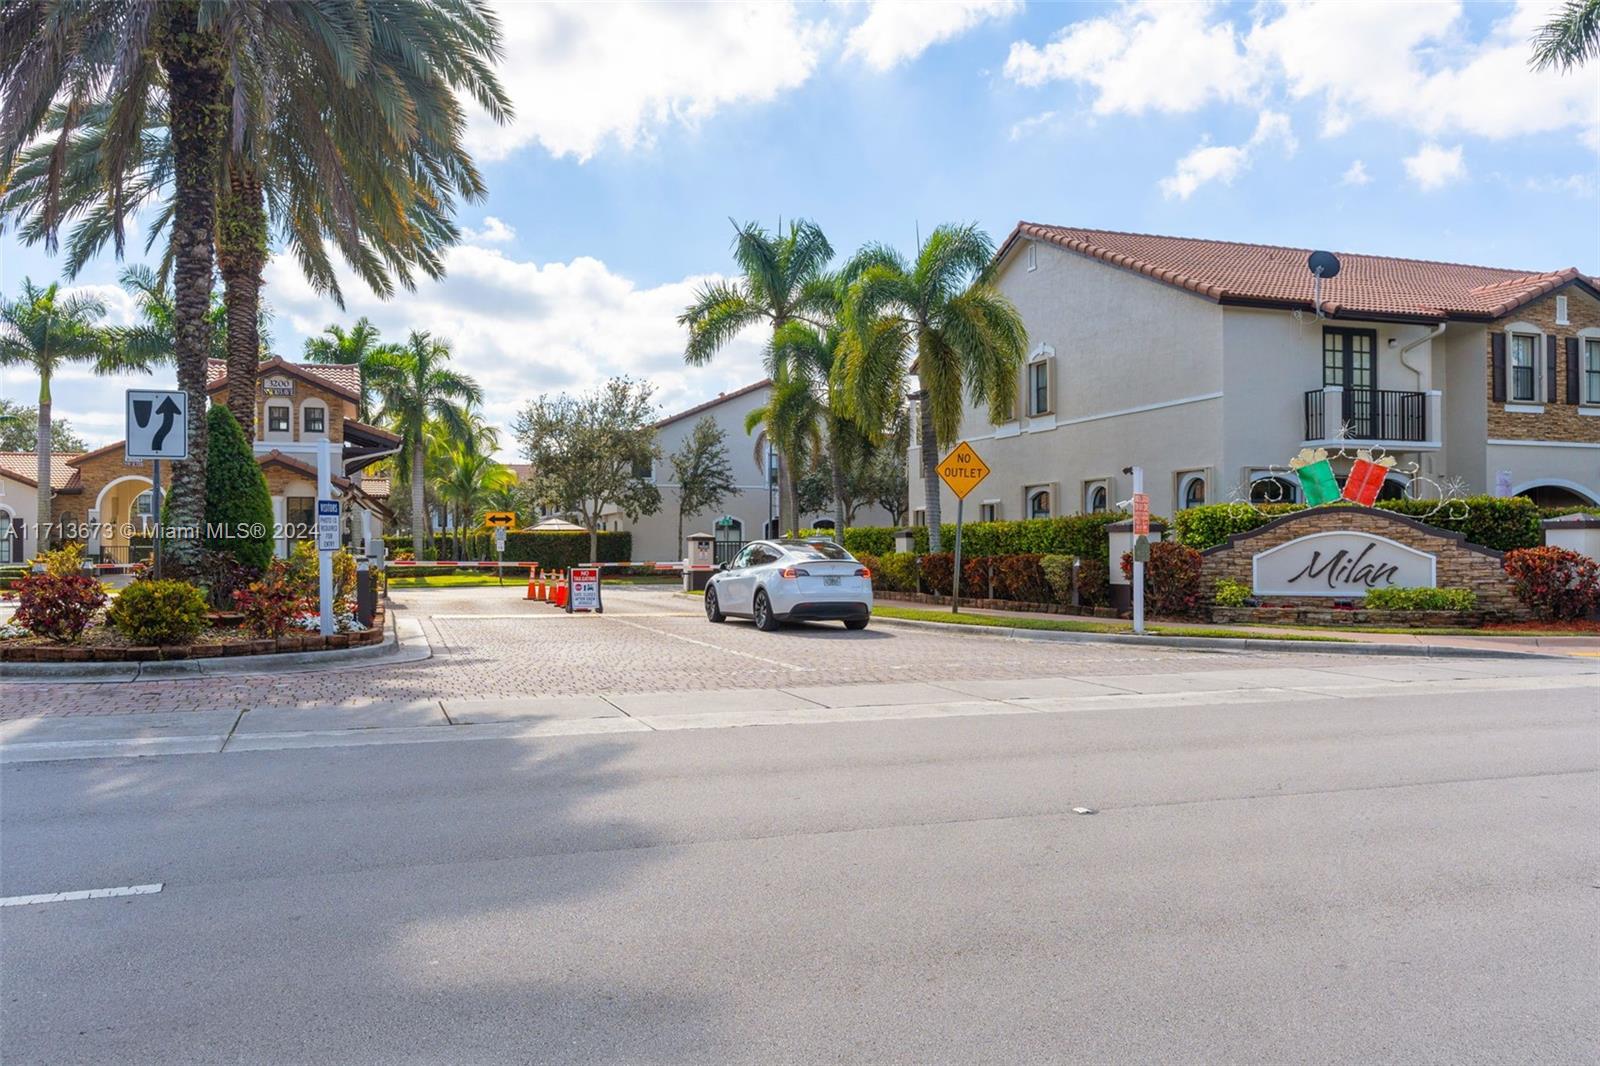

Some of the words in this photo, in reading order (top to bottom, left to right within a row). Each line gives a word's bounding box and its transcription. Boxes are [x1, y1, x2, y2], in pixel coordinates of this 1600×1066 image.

[957, 453, 971, 463] NO
[944, 467, 982, 478] OUTLET
[320, 503, 338, 512] VISITORS
[1287, 542, 1400, 589] Milan
